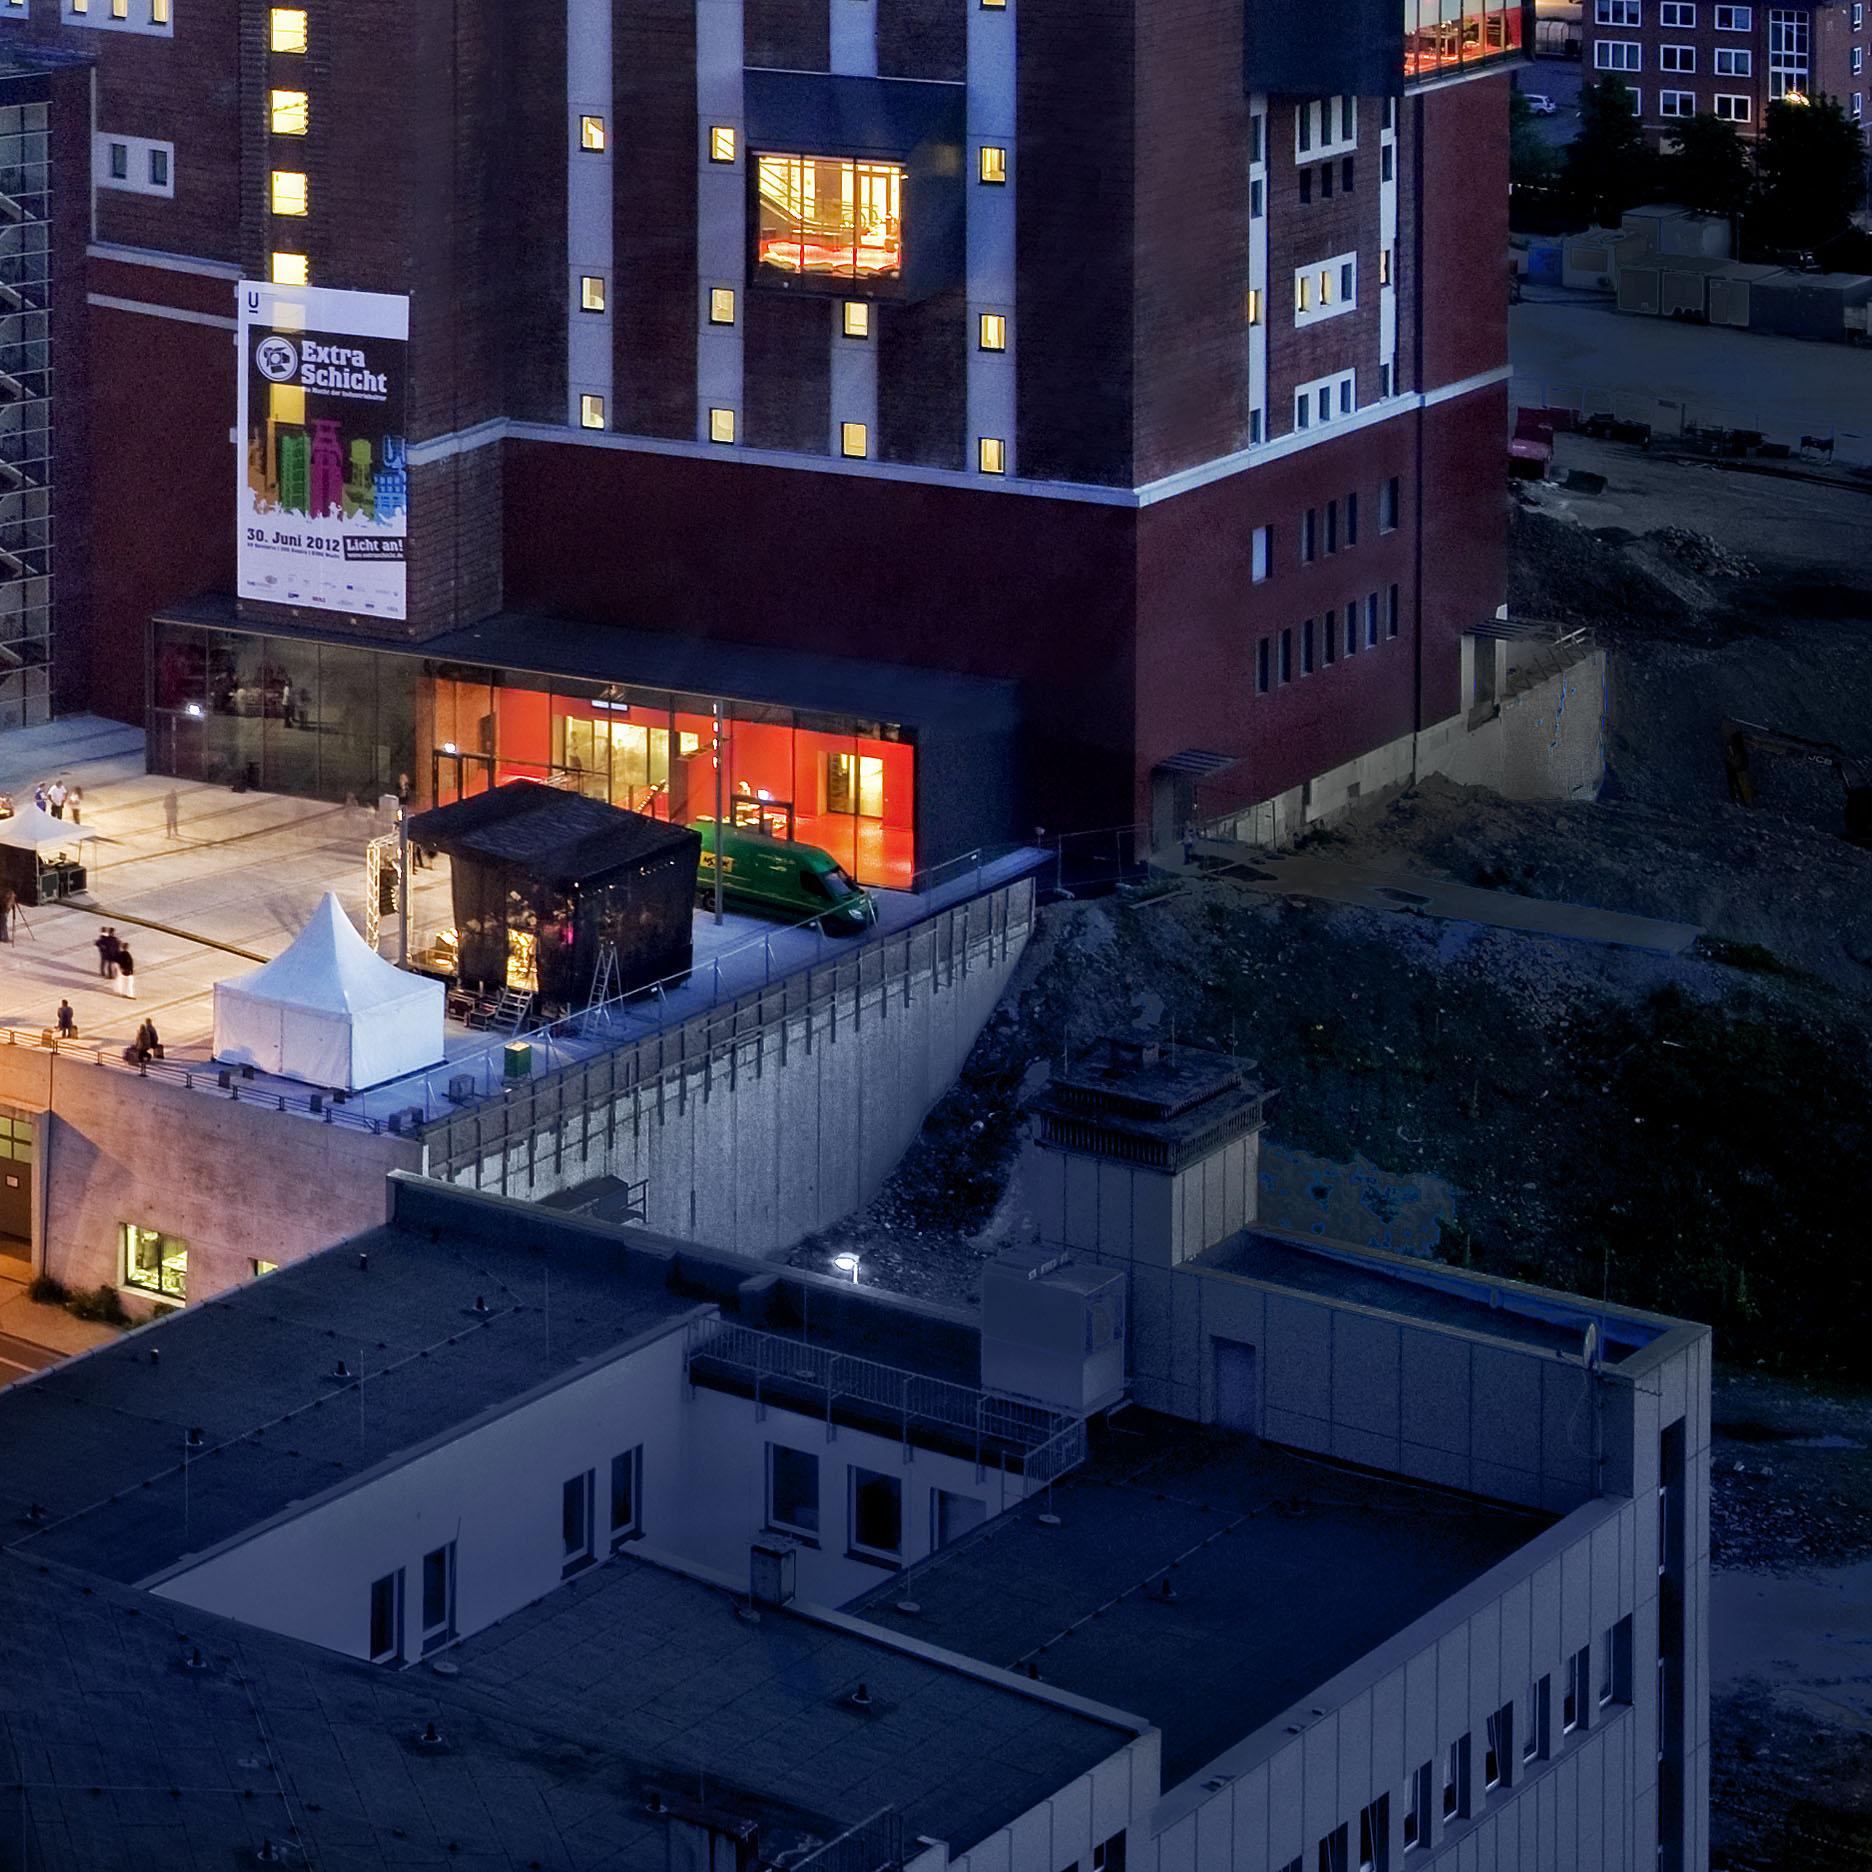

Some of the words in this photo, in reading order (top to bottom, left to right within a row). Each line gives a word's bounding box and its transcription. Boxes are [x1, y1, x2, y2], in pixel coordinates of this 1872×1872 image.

[301, 340, 366, 368] Extra
[301, 364, 388, 393] Schicht
[247, 528, 268, 543] 30.
[272, 531, 302, 547] Juni
[306, 536, 340, 552] 2012
[346, 538, 380, 551] Licht
[381, 539, 404, 552] an!
